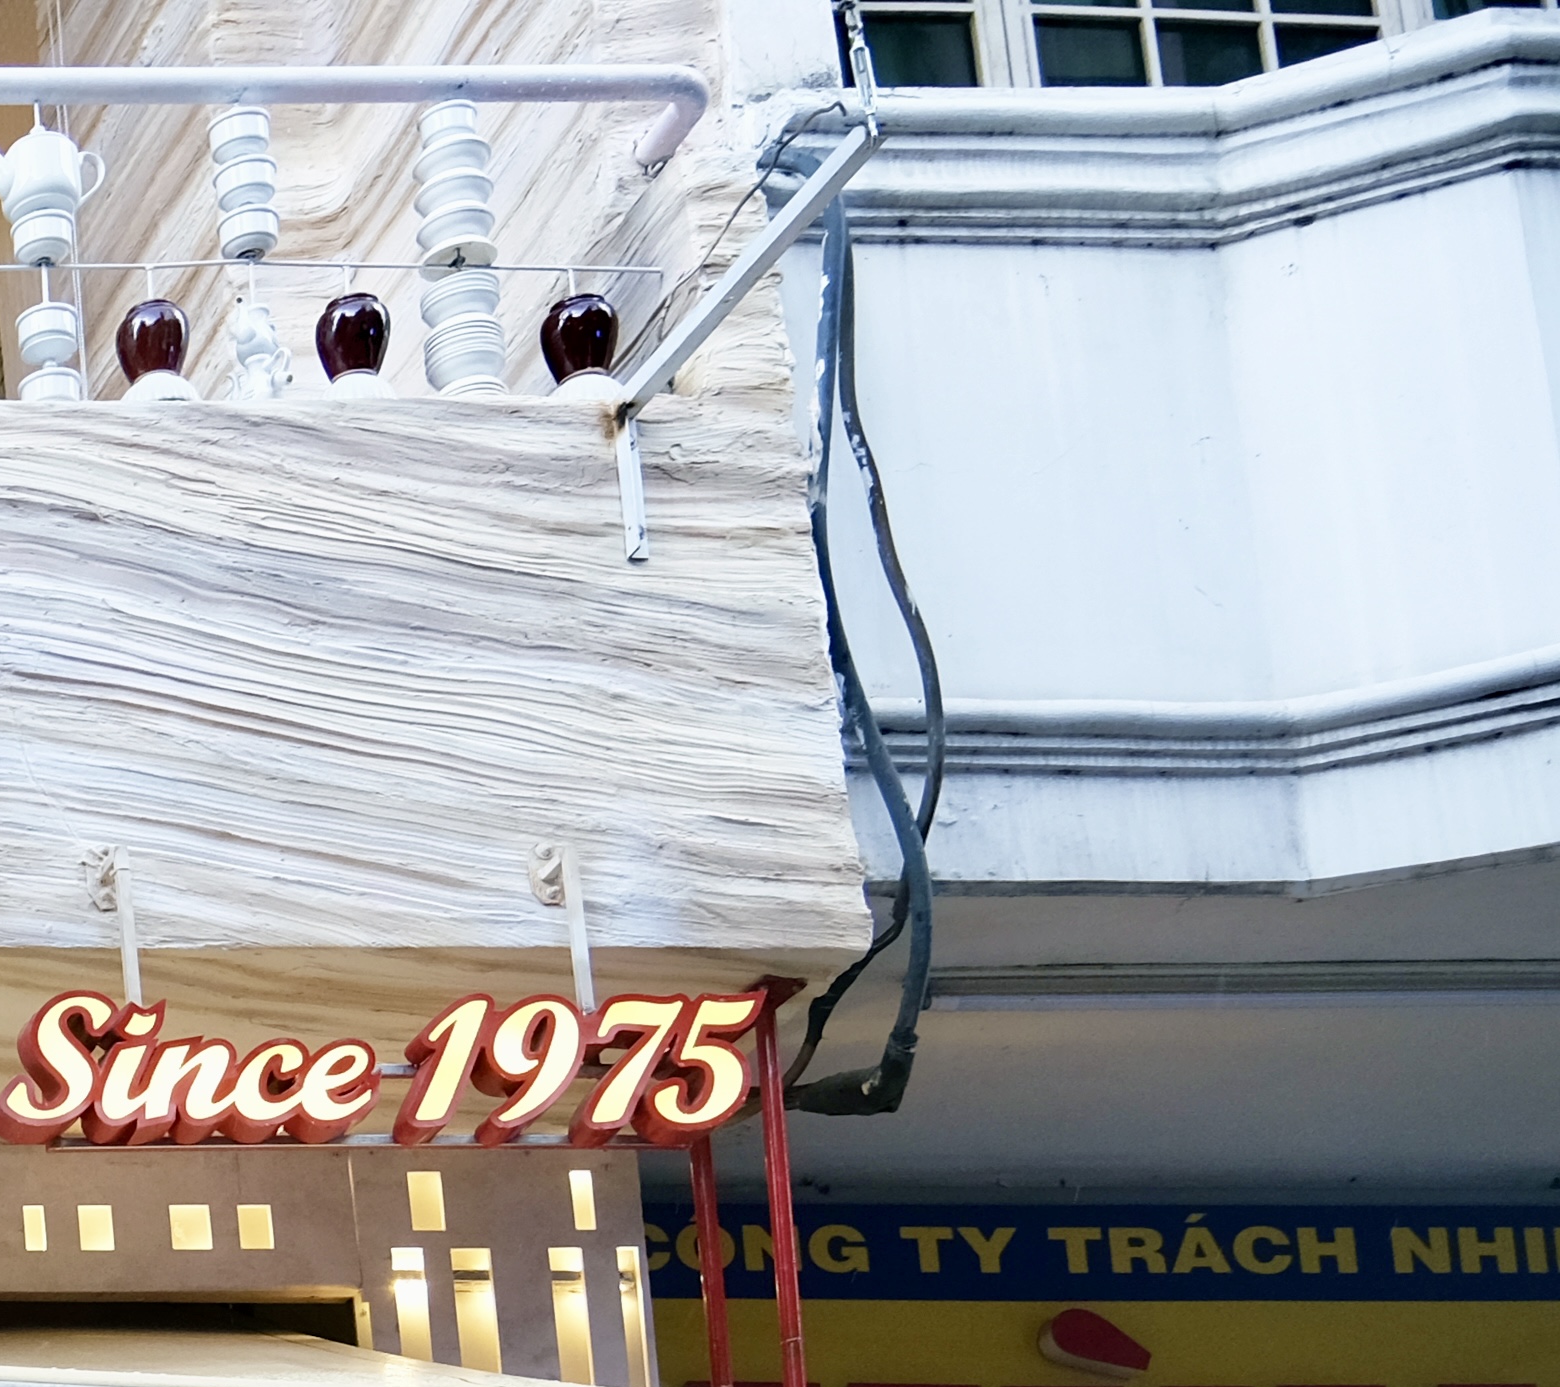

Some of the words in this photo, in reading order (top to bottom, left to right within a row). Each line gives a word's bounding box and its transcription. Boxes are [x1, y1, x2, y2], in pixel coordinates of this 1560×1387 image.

[408, 992, 765, 1132] 1975
[899, 1226, 1020, 1273] TY
[1048, 1213, 1358, 1274] TRÁCH
